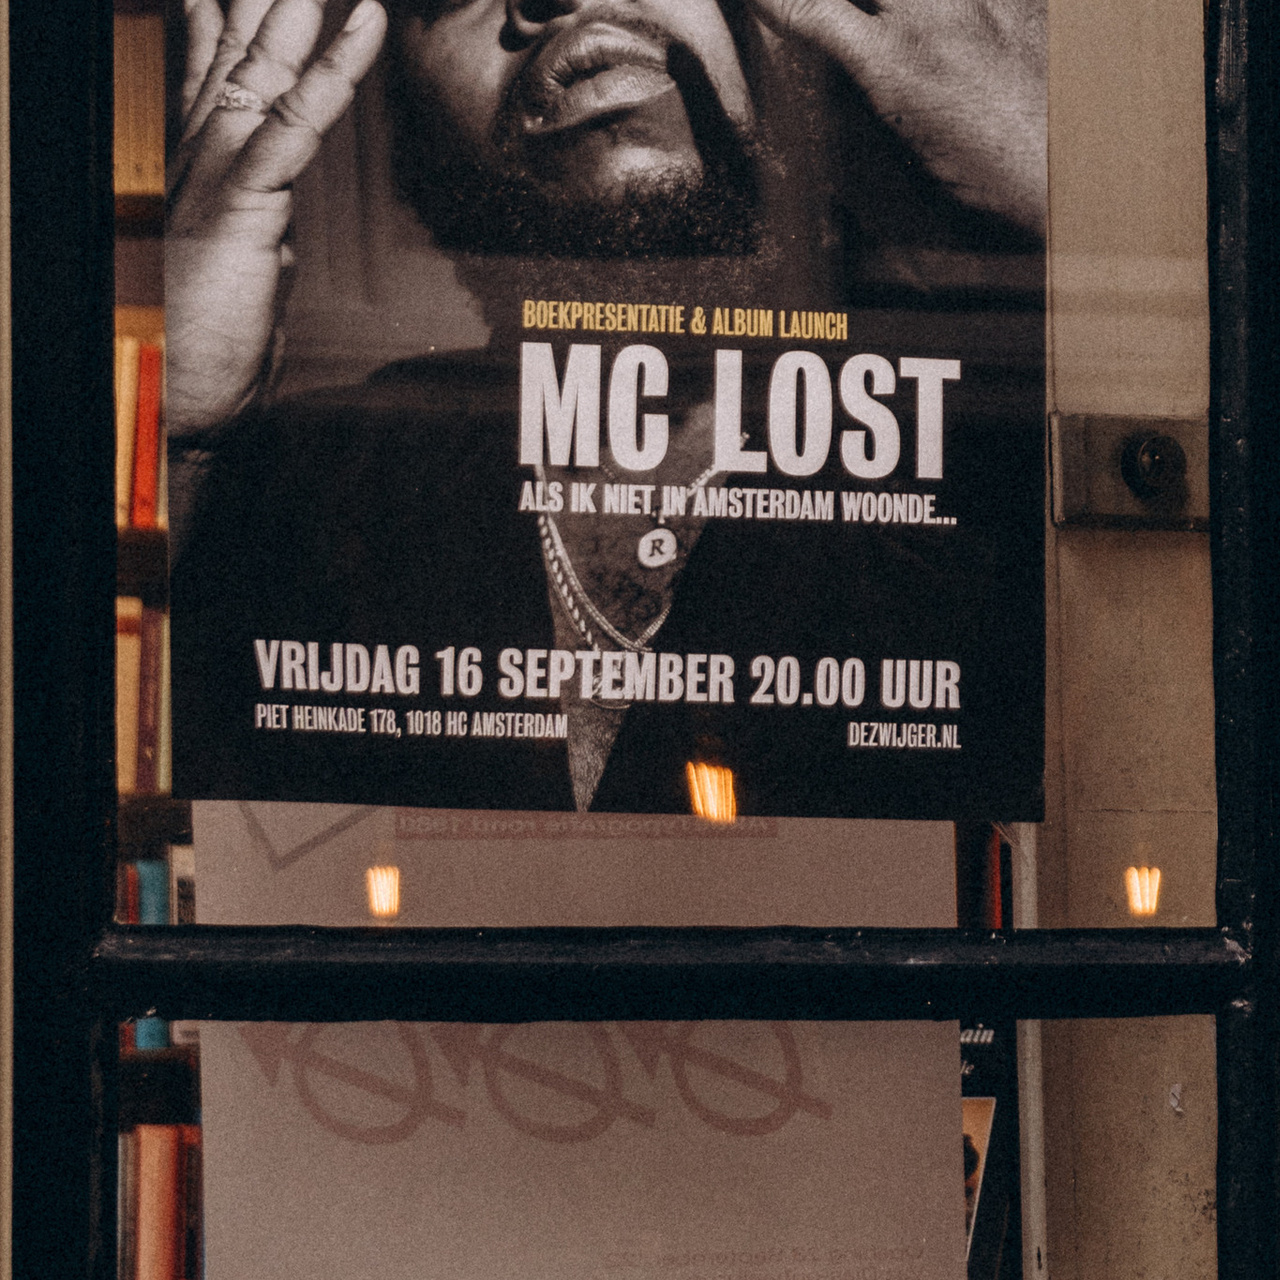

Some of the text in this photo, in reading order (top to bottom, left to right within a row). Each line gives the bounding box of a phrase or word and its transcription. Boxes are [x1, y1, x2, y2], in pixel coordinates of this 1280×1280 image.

[523, 300, 848, 340] BOEKPRESENTATIE & ALBUM LAUNCH
[519, 341, 961, 480] MC LOST
[519, 481, 958, 525] ALS IK NIET IN AMSTERDAM WOONDE...
[254, 639, 962, 709] VRIJDAG 16 SEPTEMBER 20.00 UUR
[255, 704, 568, 739] PIET HEINKADE 178, 1018 HC AMSTERDAM
[847, 722, 962, 749] DEZWIJGER.NL
